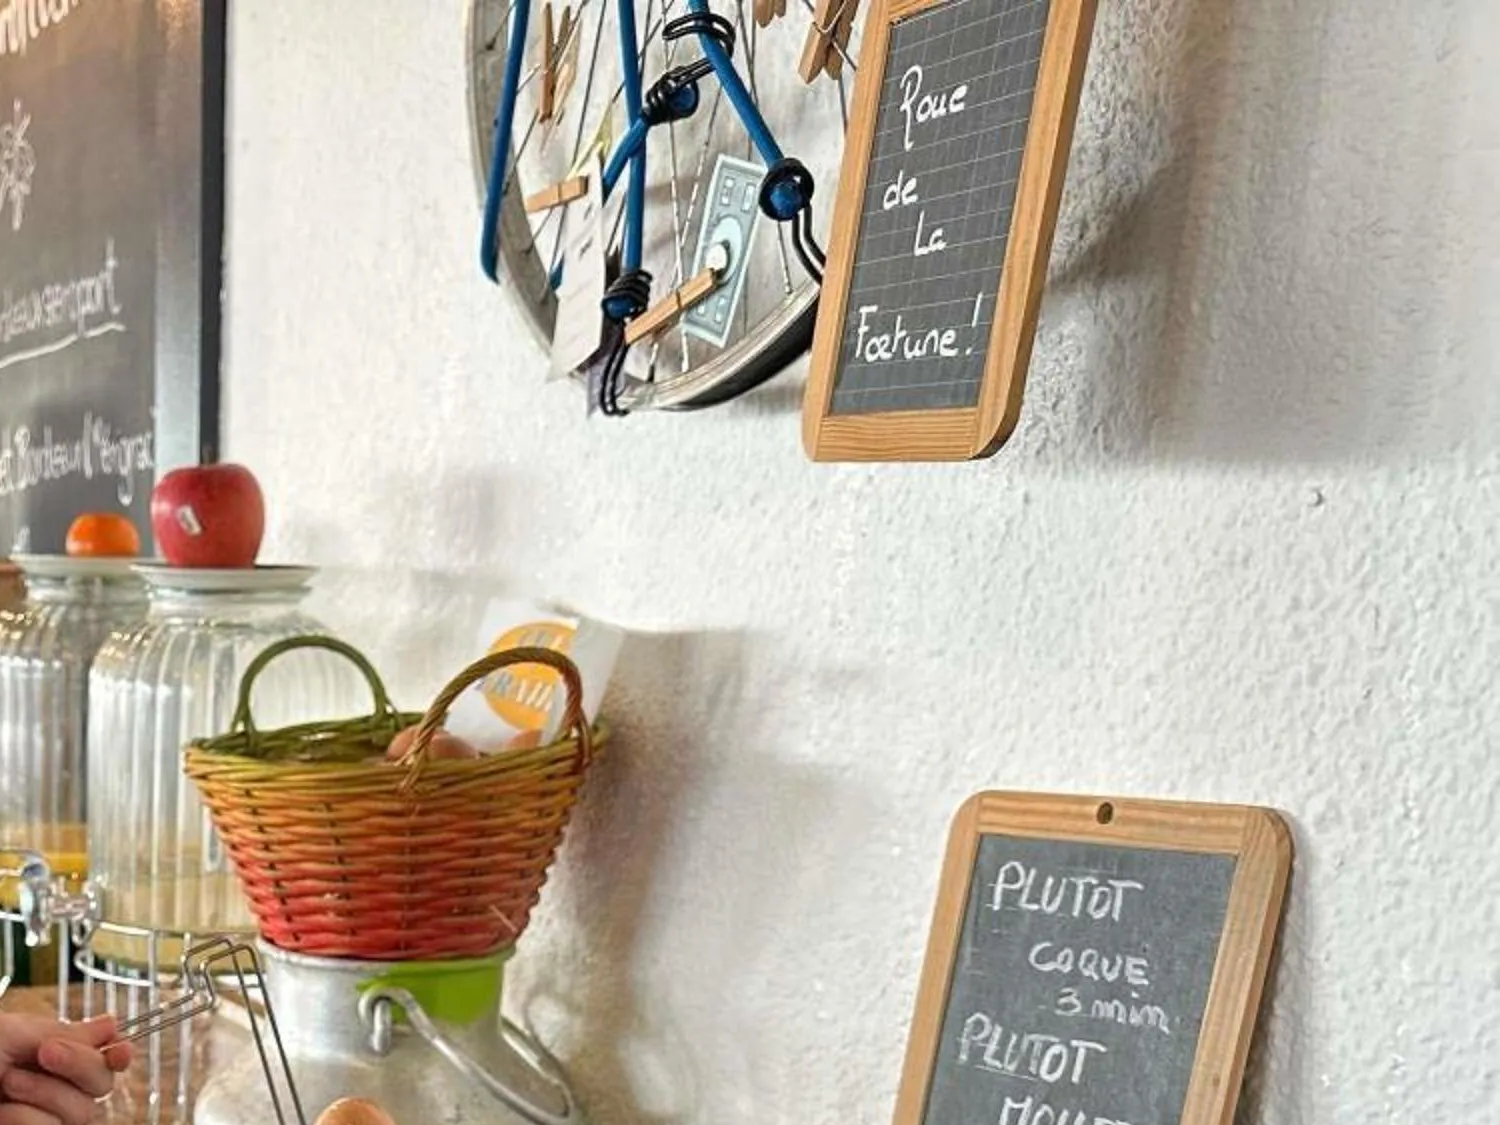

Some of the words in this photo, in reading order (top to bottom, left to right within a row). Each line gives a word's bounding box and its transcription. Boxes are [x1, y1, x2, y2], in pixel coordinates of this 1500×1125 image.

[882, 169, 919, 211] de
[991, 861, 1145, 921] PLUTOT
[1028, 941, 1150, 986] COQUE
[1054, 987, 1083, 1016] 3
[957, 1011, 1108, 1085] PLUTOT
